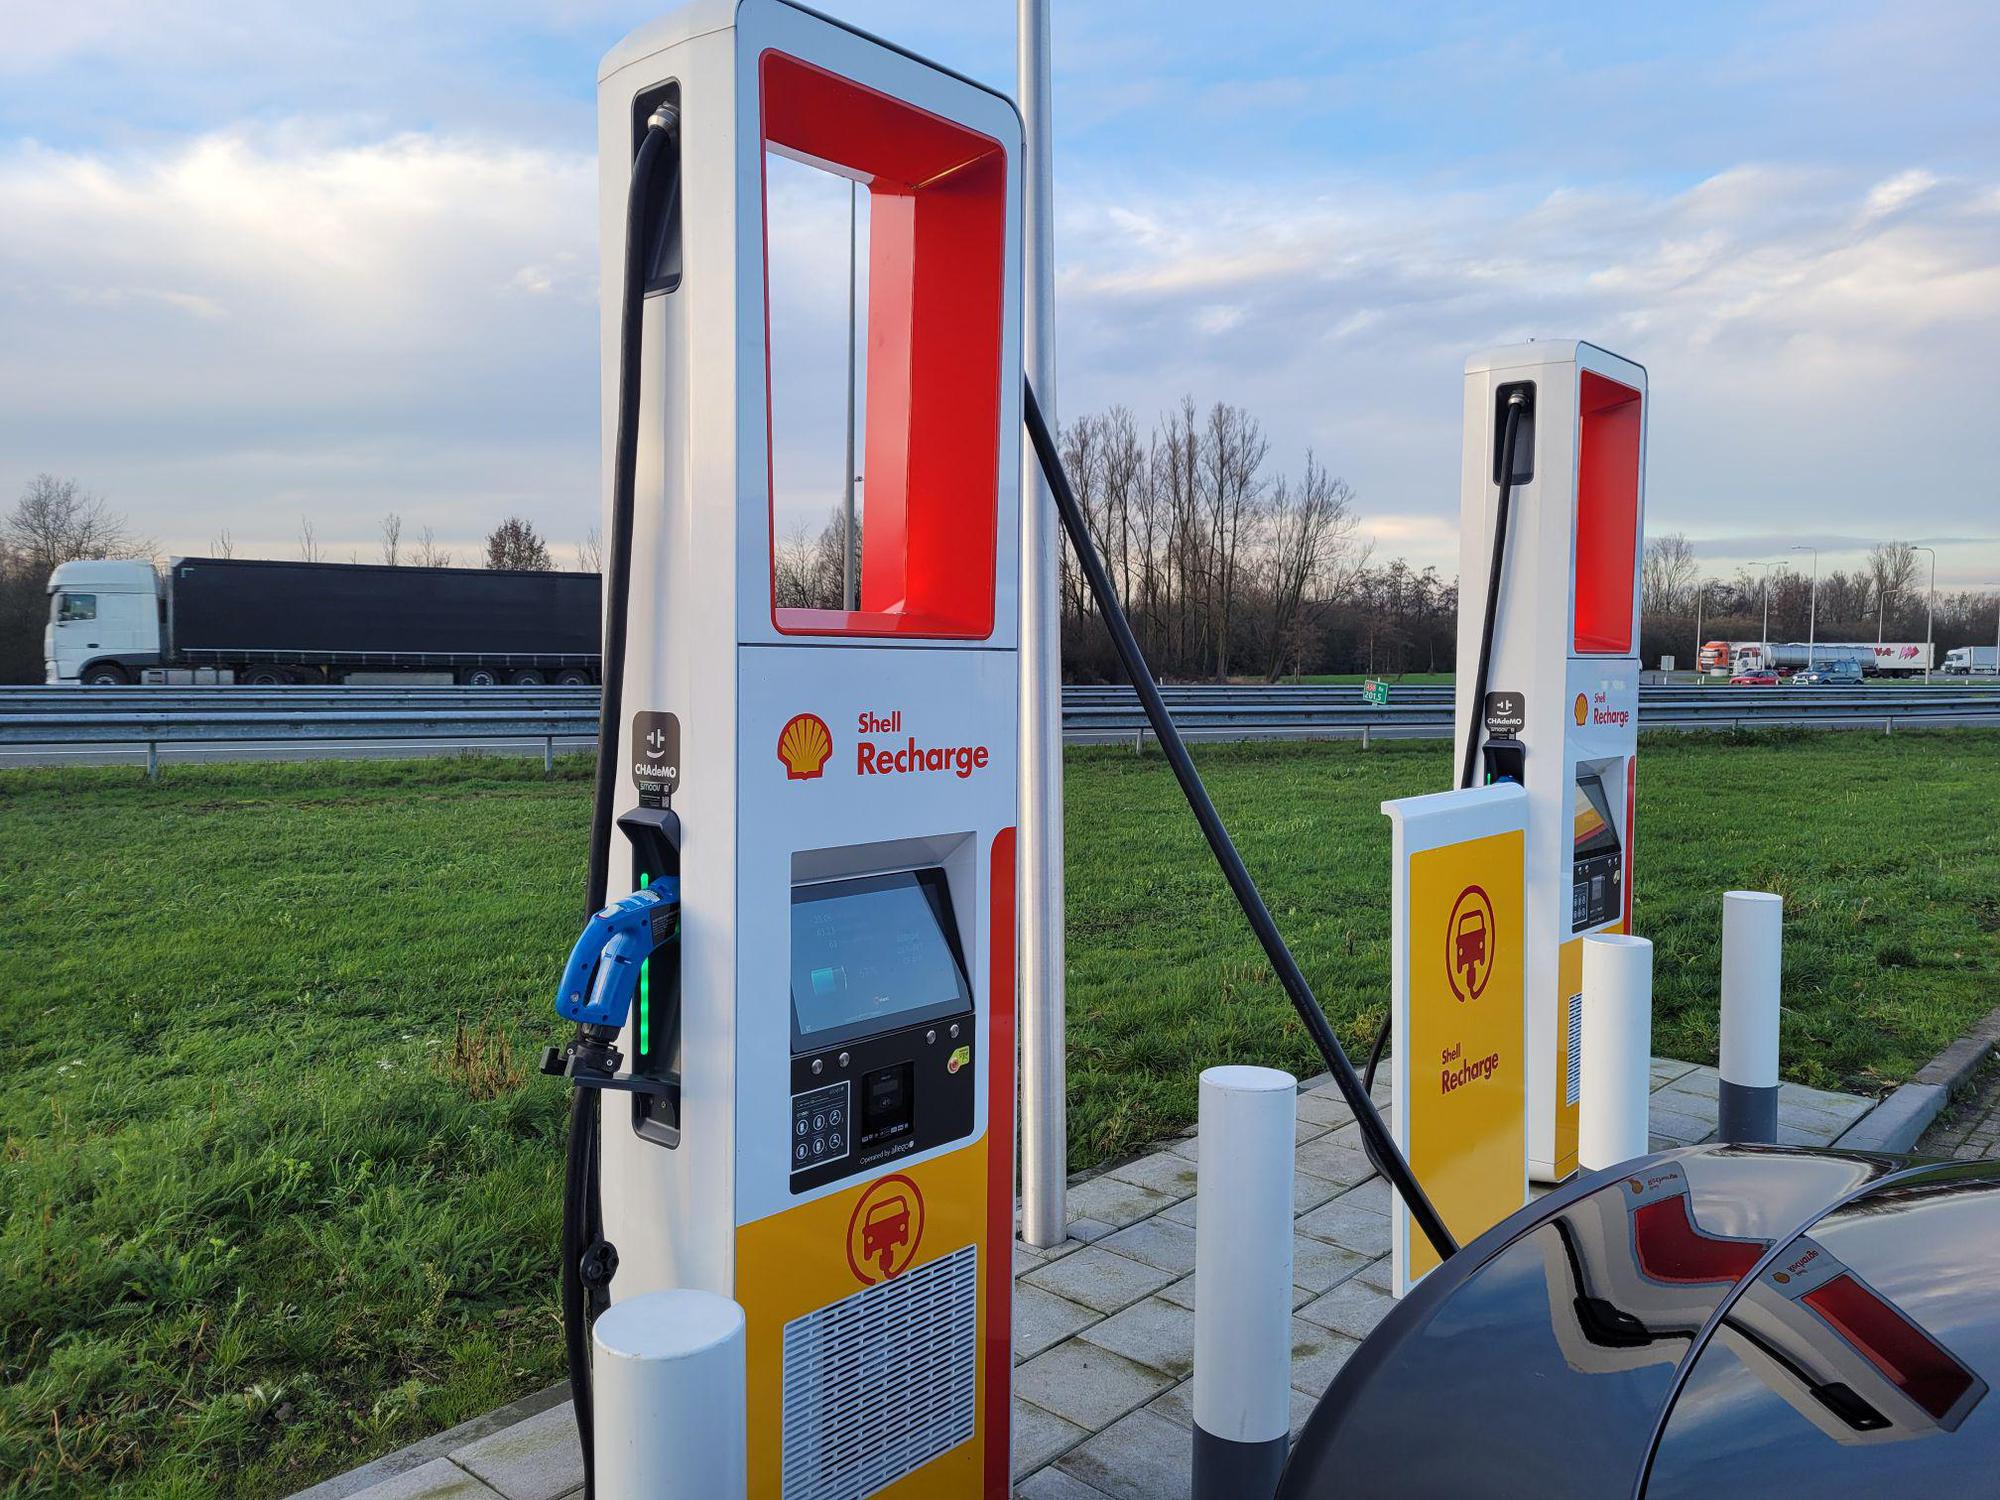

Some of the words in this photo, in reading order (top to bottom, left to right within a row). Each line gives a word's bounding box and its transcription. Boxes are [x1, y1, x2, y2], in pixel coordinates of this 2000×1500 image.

[1594, 692, 1606, 703] Shell
[858, 710, 901, 733] Shell
[1487, 717, 1522, 725] CHAdeMO
[1593, 705, 1629, 728] Recharge
[857, 736, 989, 779] Recharge
[635, 763, 677, 778] CHAdeMO
[1442, 1042, 1461, 1065] Shell
[1442, 1053, 1499, 1095] Recharge
[860, 1150, 884, 1165] Operated
